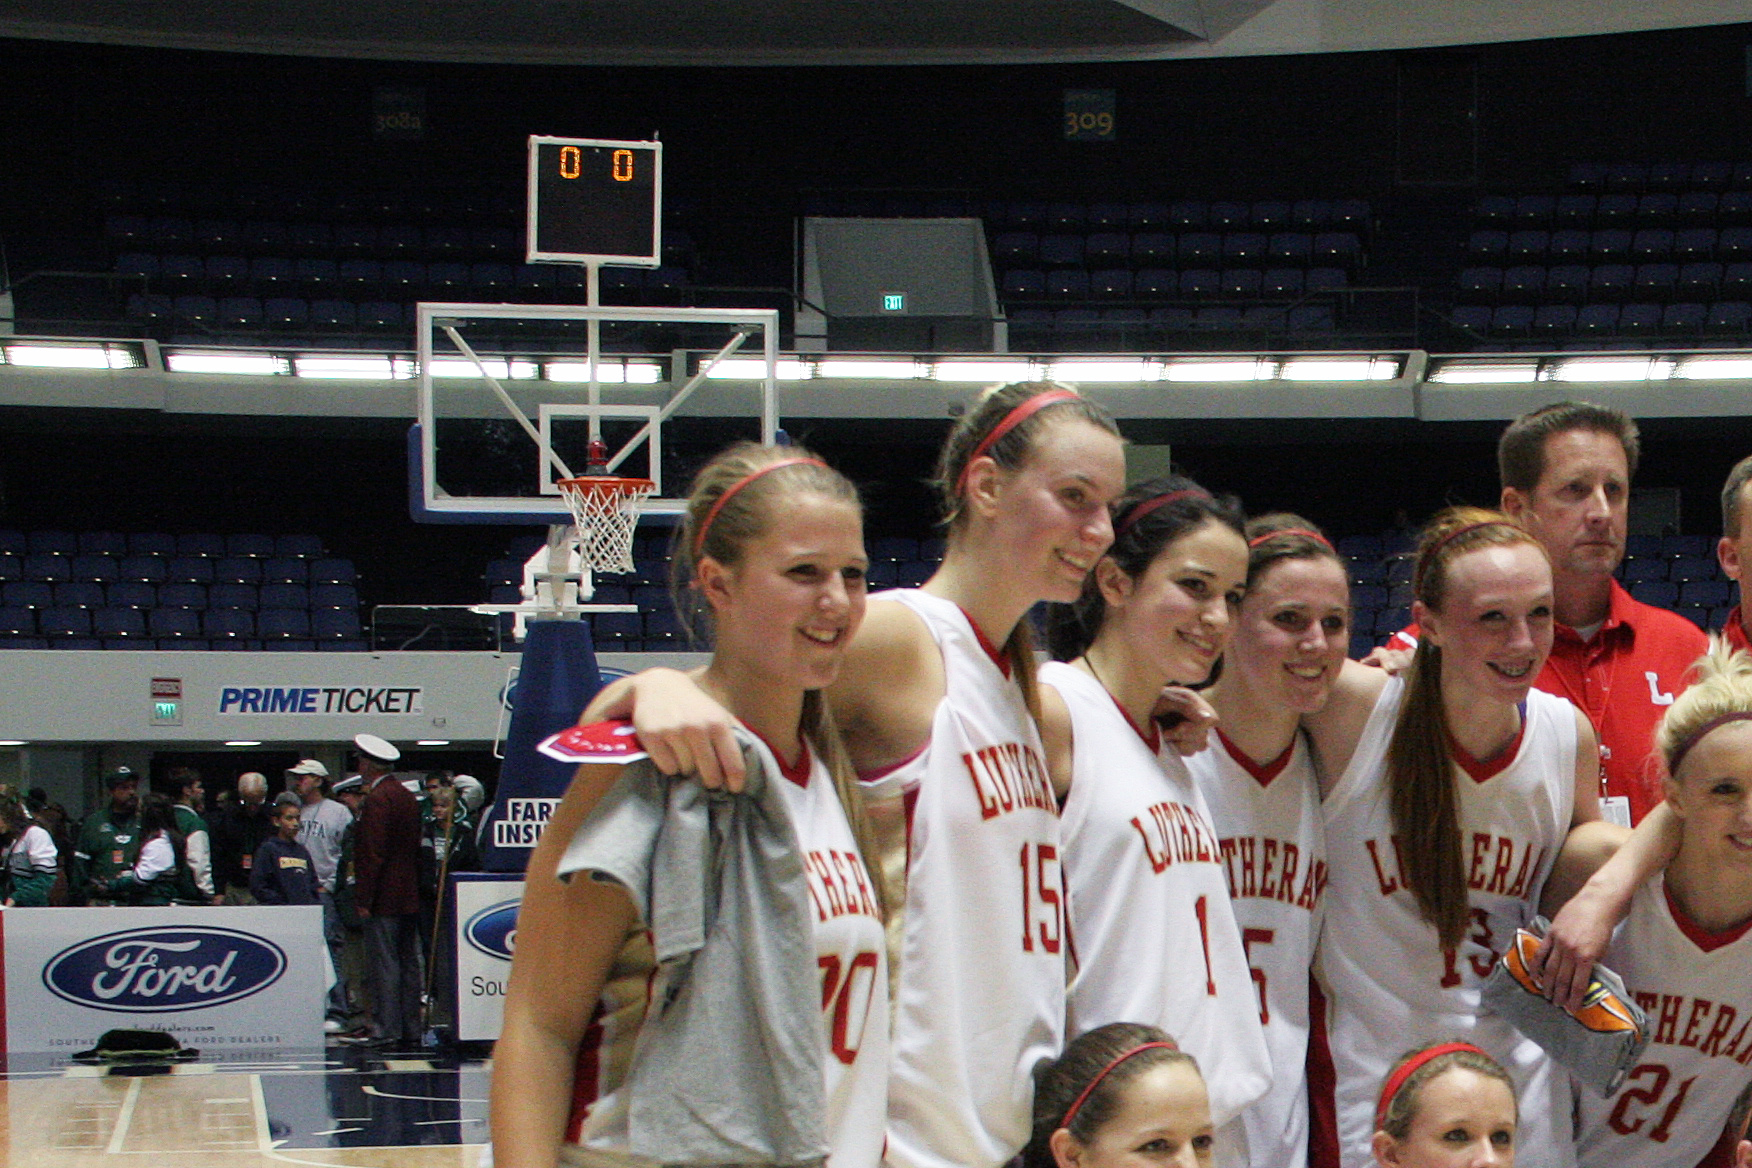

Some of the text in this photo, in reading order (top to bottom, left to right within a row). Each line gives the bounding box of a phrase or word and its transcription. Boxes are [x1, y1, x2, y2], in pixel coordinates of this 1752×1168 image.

[1065, 111, 1114, 136] 309
[560, 146, 634, 182] 0 0
[1645, 671, 1674, 705] L
[1020, 842, 1060, 954] 15
[92, 940, 238, 999] Ford
[1195, 895, 1217, 997] 1
[1608, 1063, 1699, 1143] 21
